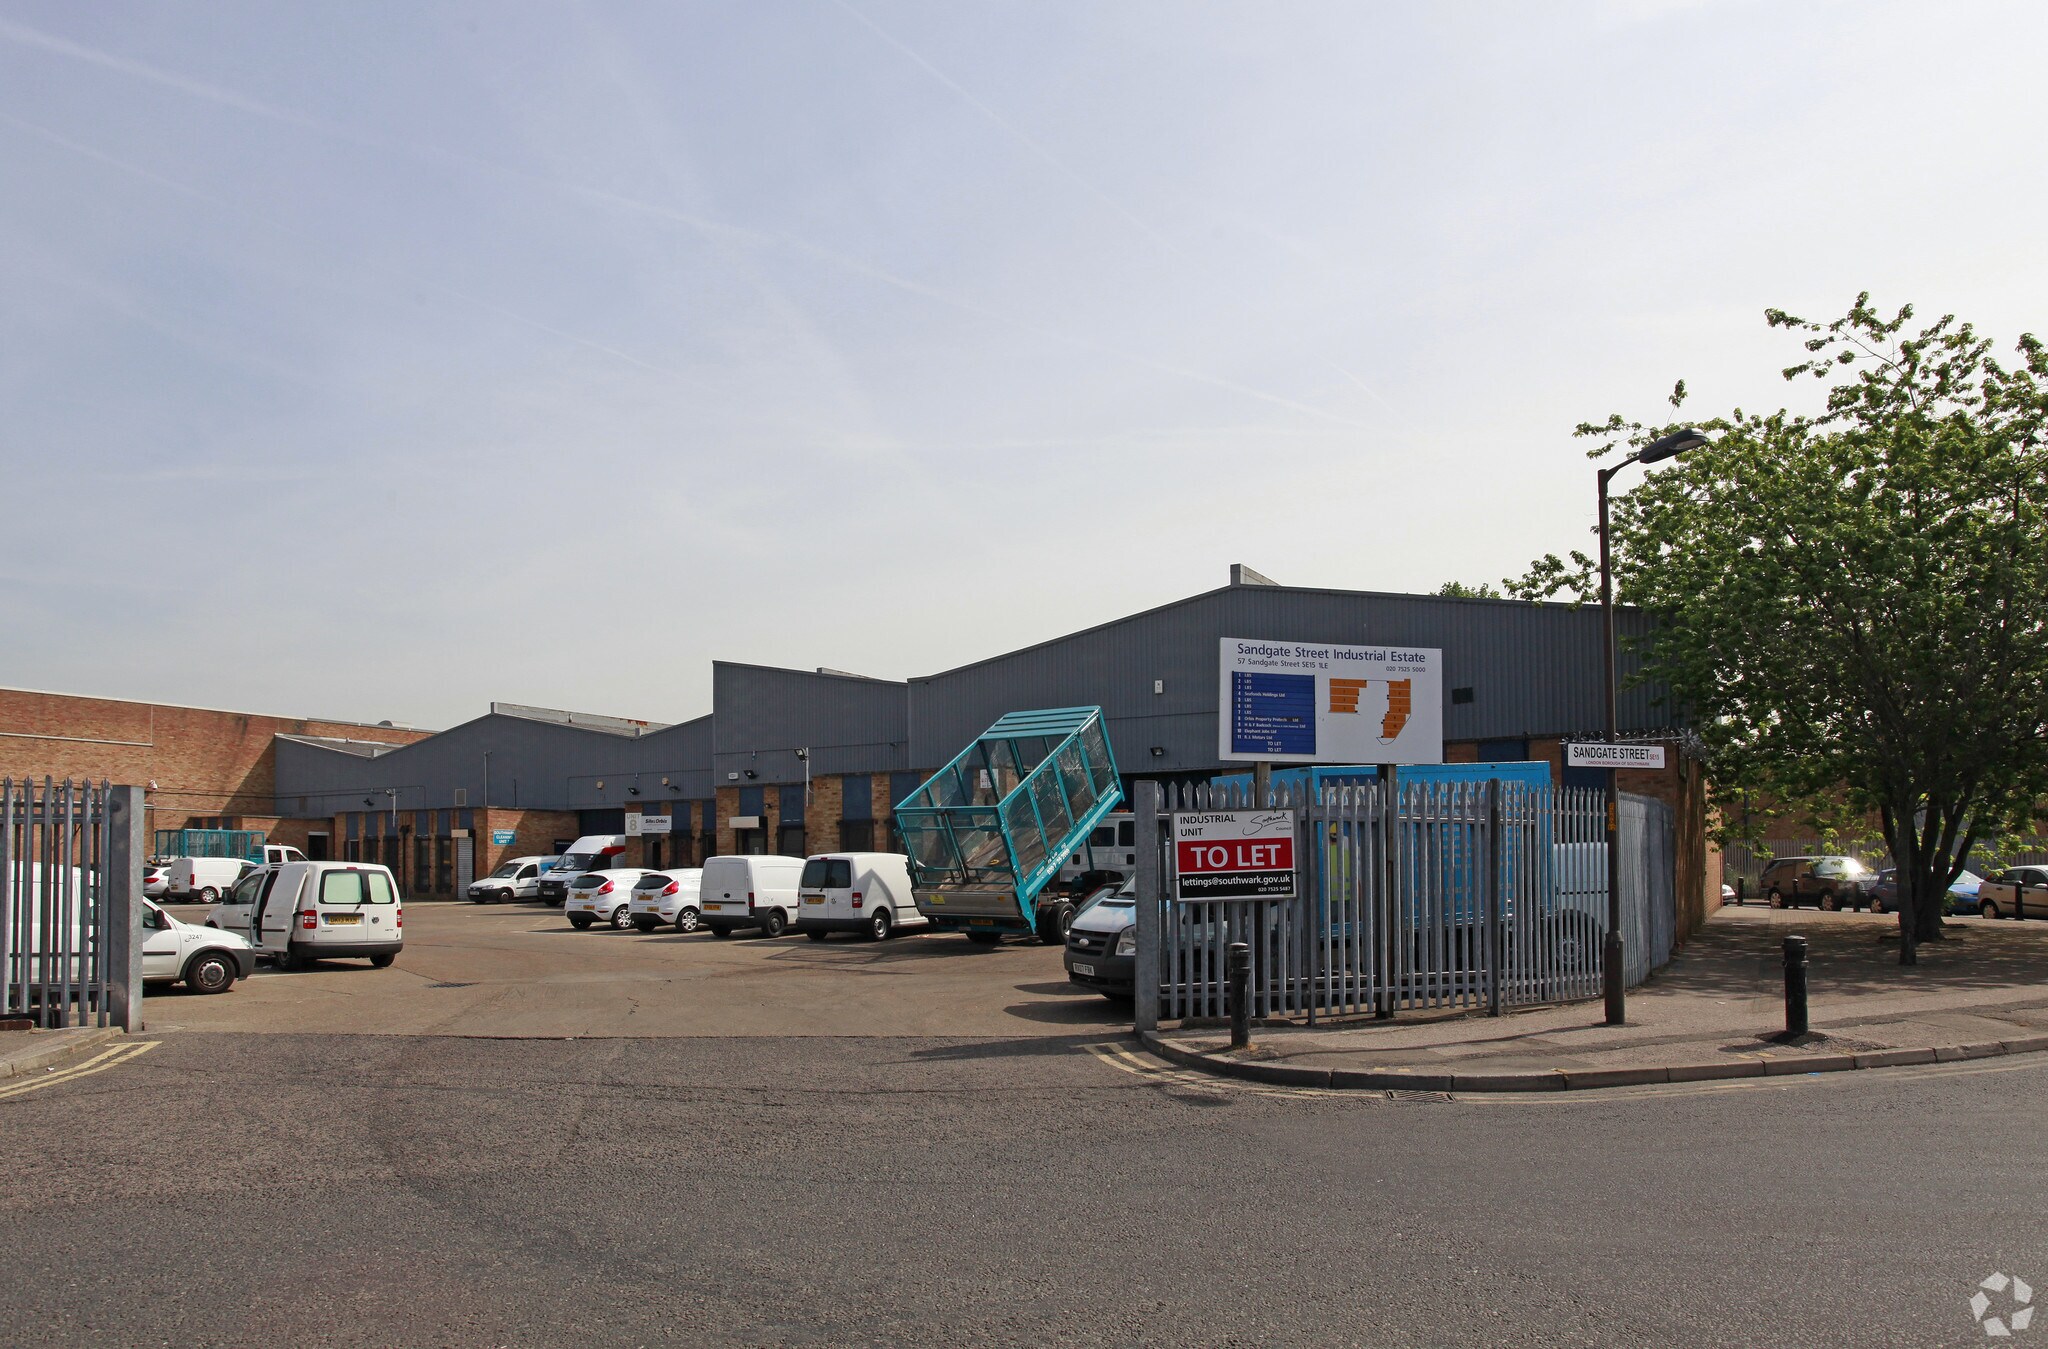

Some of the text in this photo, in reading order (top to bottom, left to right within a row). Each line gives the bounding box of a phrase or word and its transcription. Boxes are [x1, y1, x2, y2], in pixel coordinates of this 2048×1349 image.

[1237, 643, 1426, 662] Sandgate Street Industrial Estate
[1248, 658, 1278, 668] Sandgate
[1574, 746, 1618, 759] SANDGATE
[1620, 748, 1650, 760] STREET
[630, 820, 638, 831] 8
[1180, 814, 1236, 824] INDUSTRIAL
[1242, 812, 1292, 836] Southwark
[1180, 828, 1203, 836] UNIT
[1190, 844, 1281, 868] TO LET
[1182, 874, 1290, 887] lettings@southwark.gov.uk
